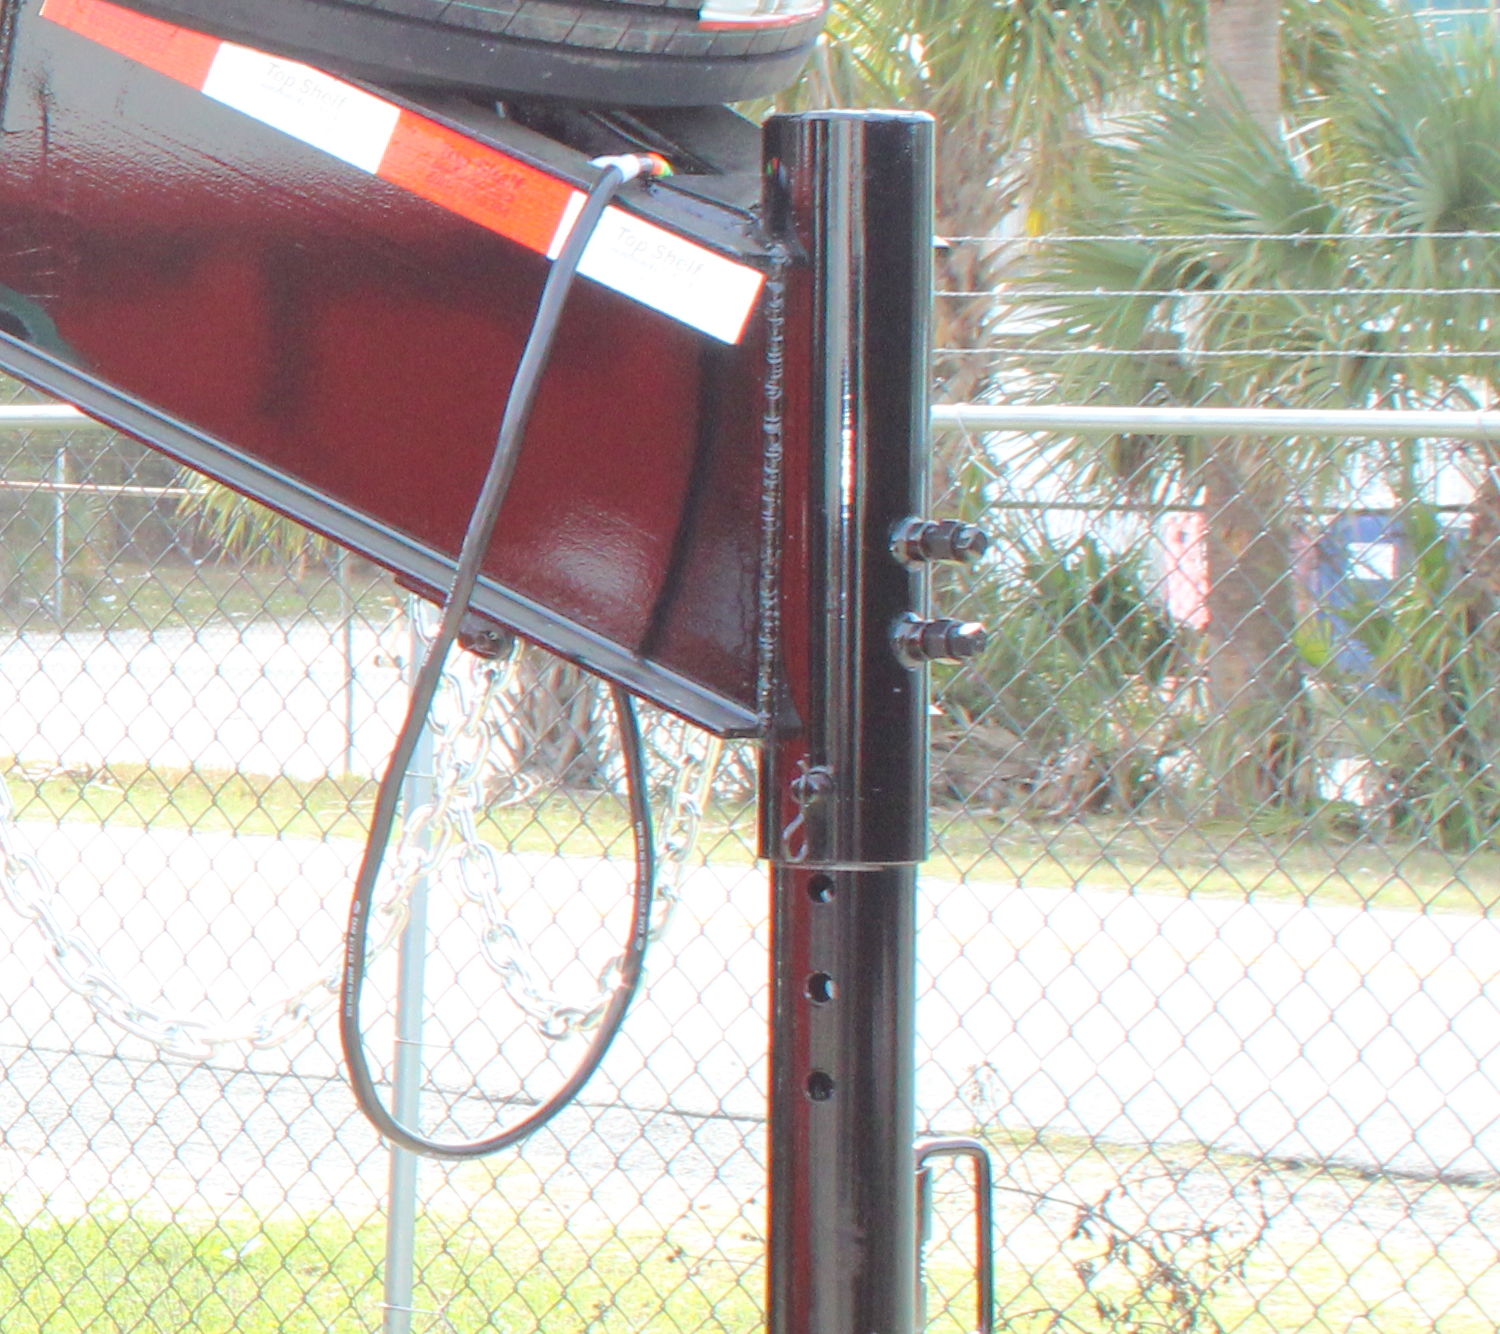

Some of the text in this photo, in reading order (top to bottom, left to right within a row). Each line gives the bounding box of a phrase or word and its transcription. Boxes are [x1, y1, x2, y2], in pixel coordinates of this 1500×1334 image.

[265, 61, 348, 110] Top Shelf
[615, 226, 704, 276] Top Shelf
